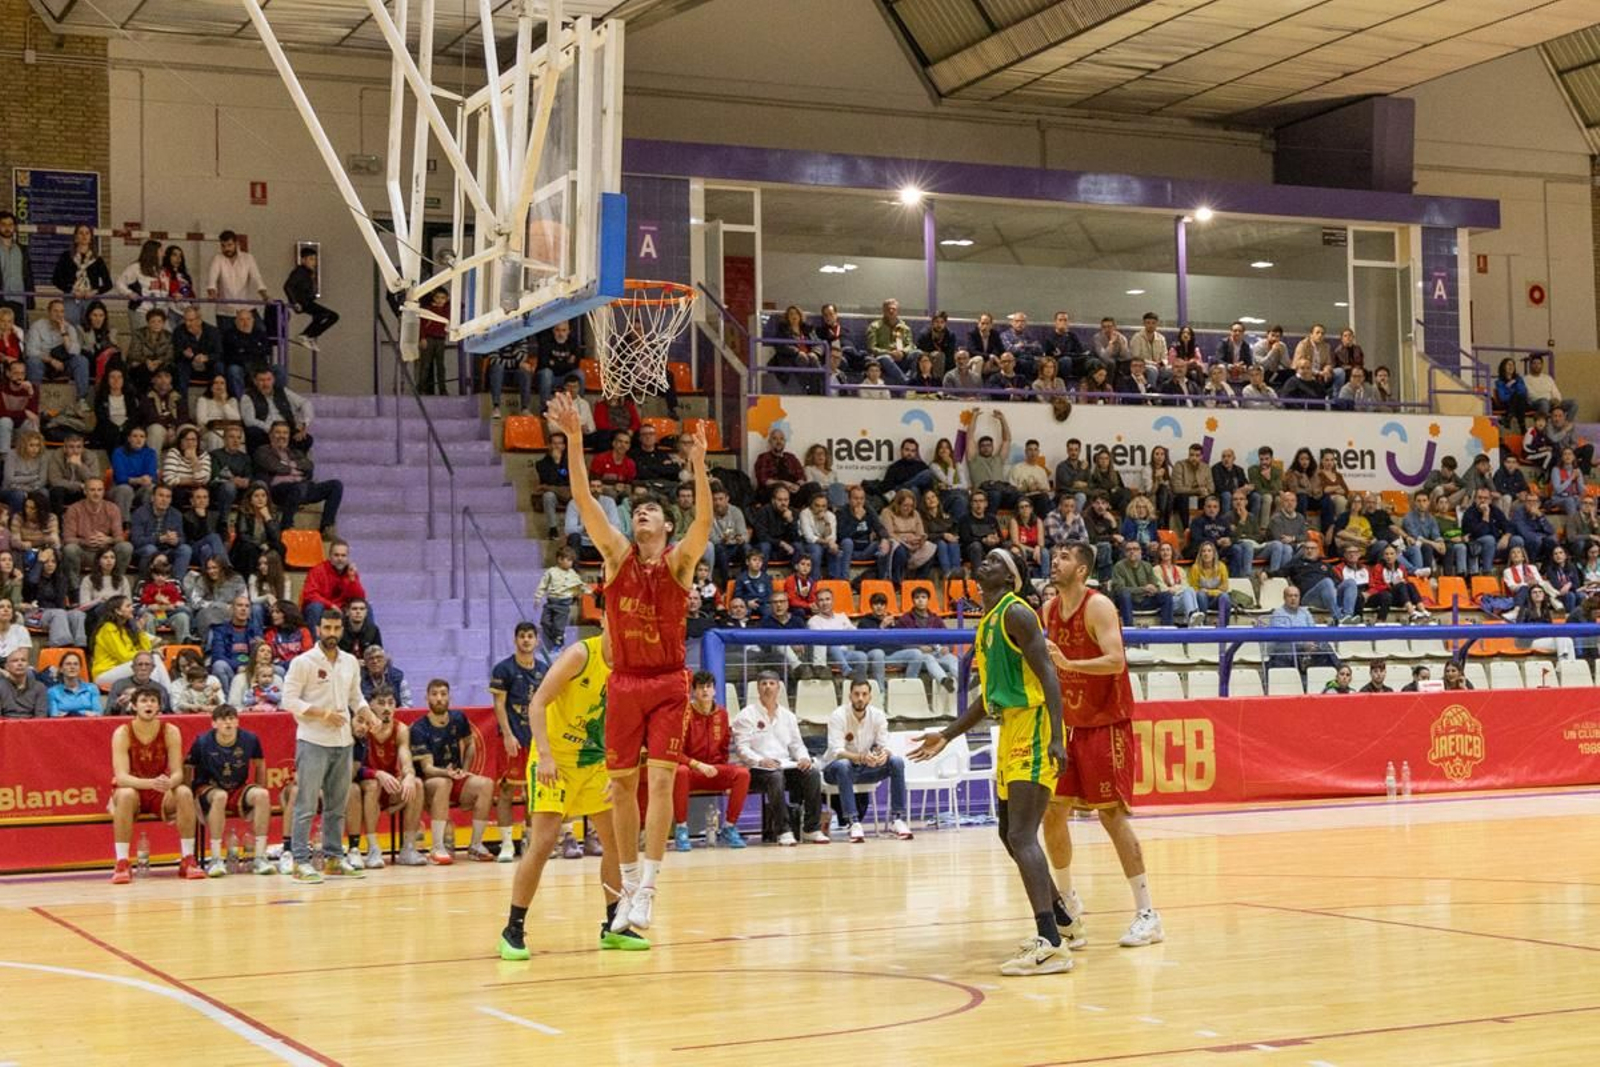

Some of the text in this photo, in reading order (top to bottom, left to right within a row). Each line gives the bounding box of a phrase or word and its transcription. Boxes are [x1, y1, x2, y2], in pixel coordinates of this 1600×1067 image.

[639, 233, 658, 259] A
[1433, 279, 1447, 300] A
[0, 784, 97, 812] Blanca
